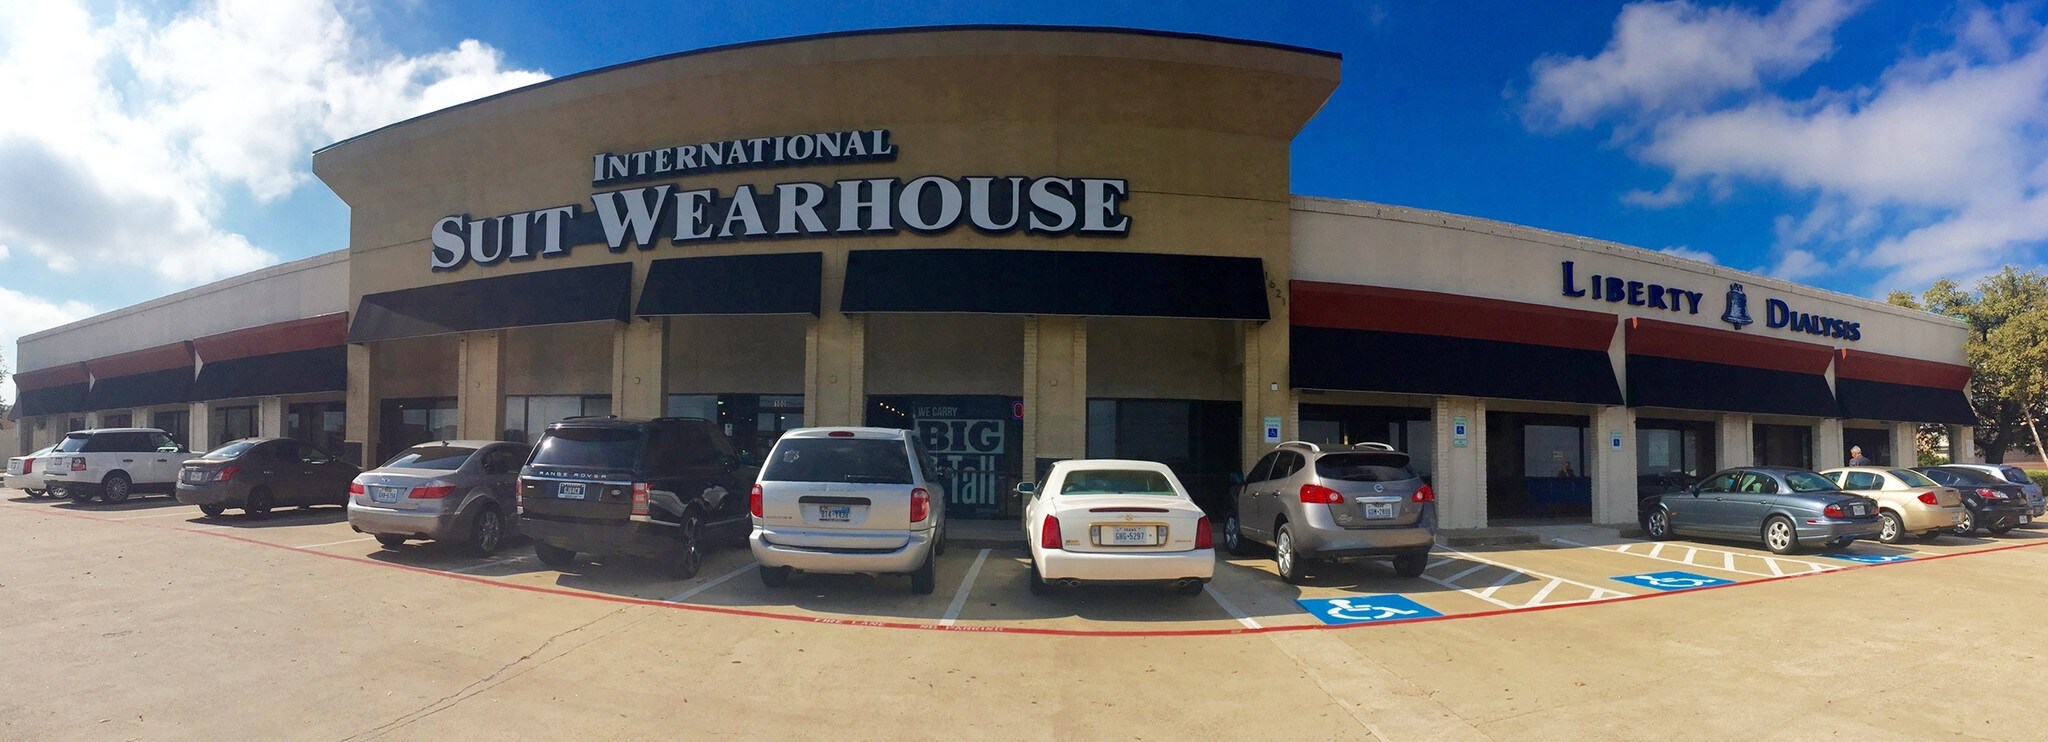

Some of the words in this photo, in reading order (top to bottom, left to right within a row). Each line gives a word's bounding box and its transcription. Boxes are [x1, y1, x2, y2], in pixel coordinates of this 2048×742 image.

[592, 129, 895, 184] INTERNATIONAL
[431, 205, 575, 269] SUIT
[591, 175, 1130, 249] WEARHOUSE
[1562, 260, 1703, 314] LIBERTY
[1765, 298, 1861, 341] DIALYSIS
[917, 420, 1001, 452] BIG
[918, 406, 931, 417] WE
[932, 406, 958, 417] CARRY
[947, 455, 996, 505] Tall
